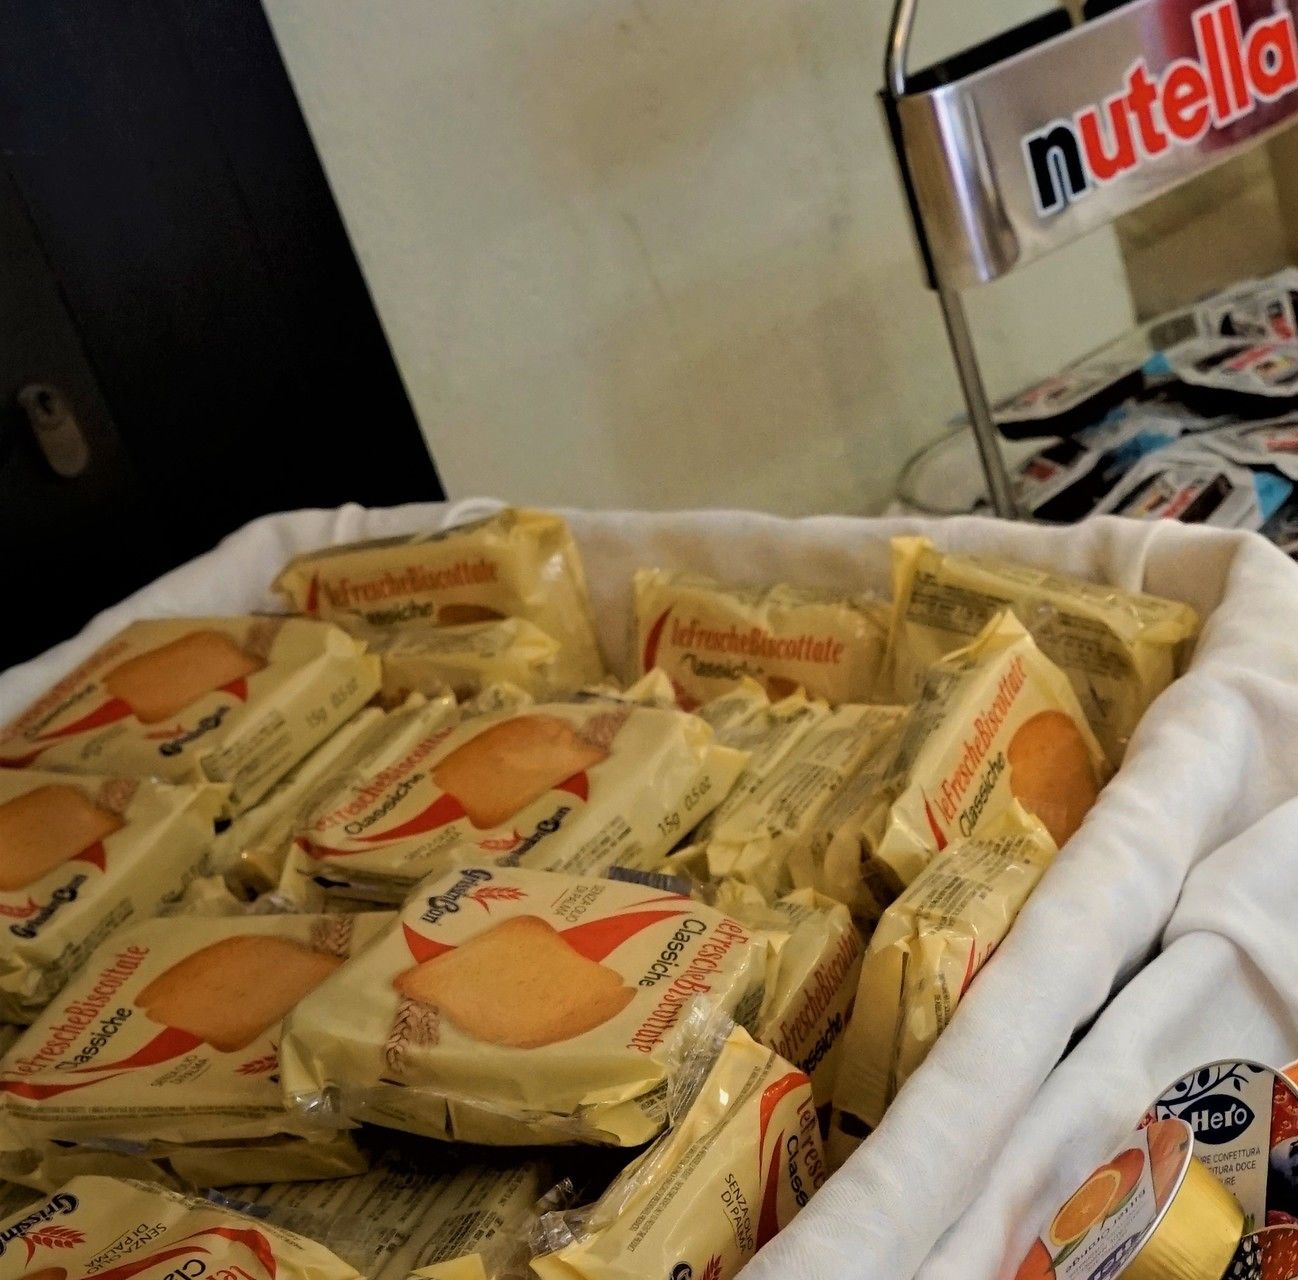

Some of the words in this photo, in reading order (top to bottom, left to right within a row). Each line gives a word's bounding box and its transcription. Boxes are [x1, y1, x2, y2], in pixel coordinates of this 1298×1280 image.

[638, 918, 707, 987] Classiche
[626, 918, 749, 1054] leFrescheBiscottate
[1190, 1103, 1248, 1133] Hero
[1213, 1147, 1261, 1164] CONFETTURA
[1235, 1160, 1256, 1170] DOCE
[720, 1190, 732, 1208] DI
[725, 1173, 750, 1217] SENZA
[121, 1222, 168, 1259] SENZA
[133, 1222, 150, 1235] DI
